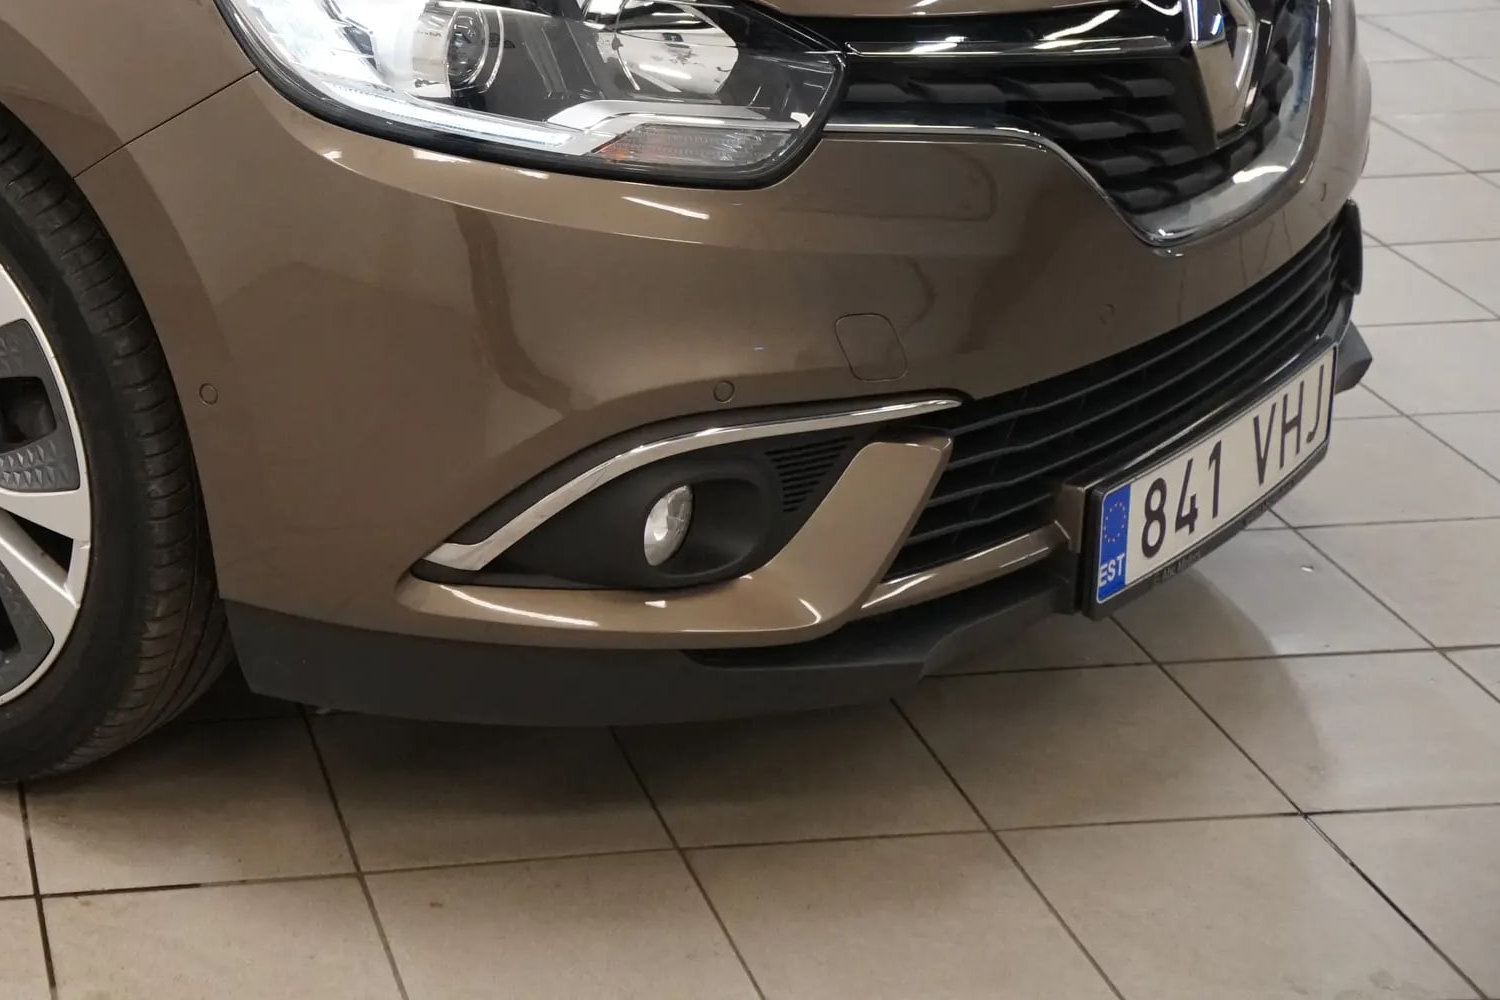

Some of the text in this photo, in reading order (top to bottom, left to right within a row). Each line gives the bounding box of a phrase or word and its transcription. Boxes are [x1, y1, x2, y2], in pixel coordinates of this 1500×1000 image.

[1141, 364, 1326, 558] 841 VHJ
[1098, 552, 1126, 587] EST
